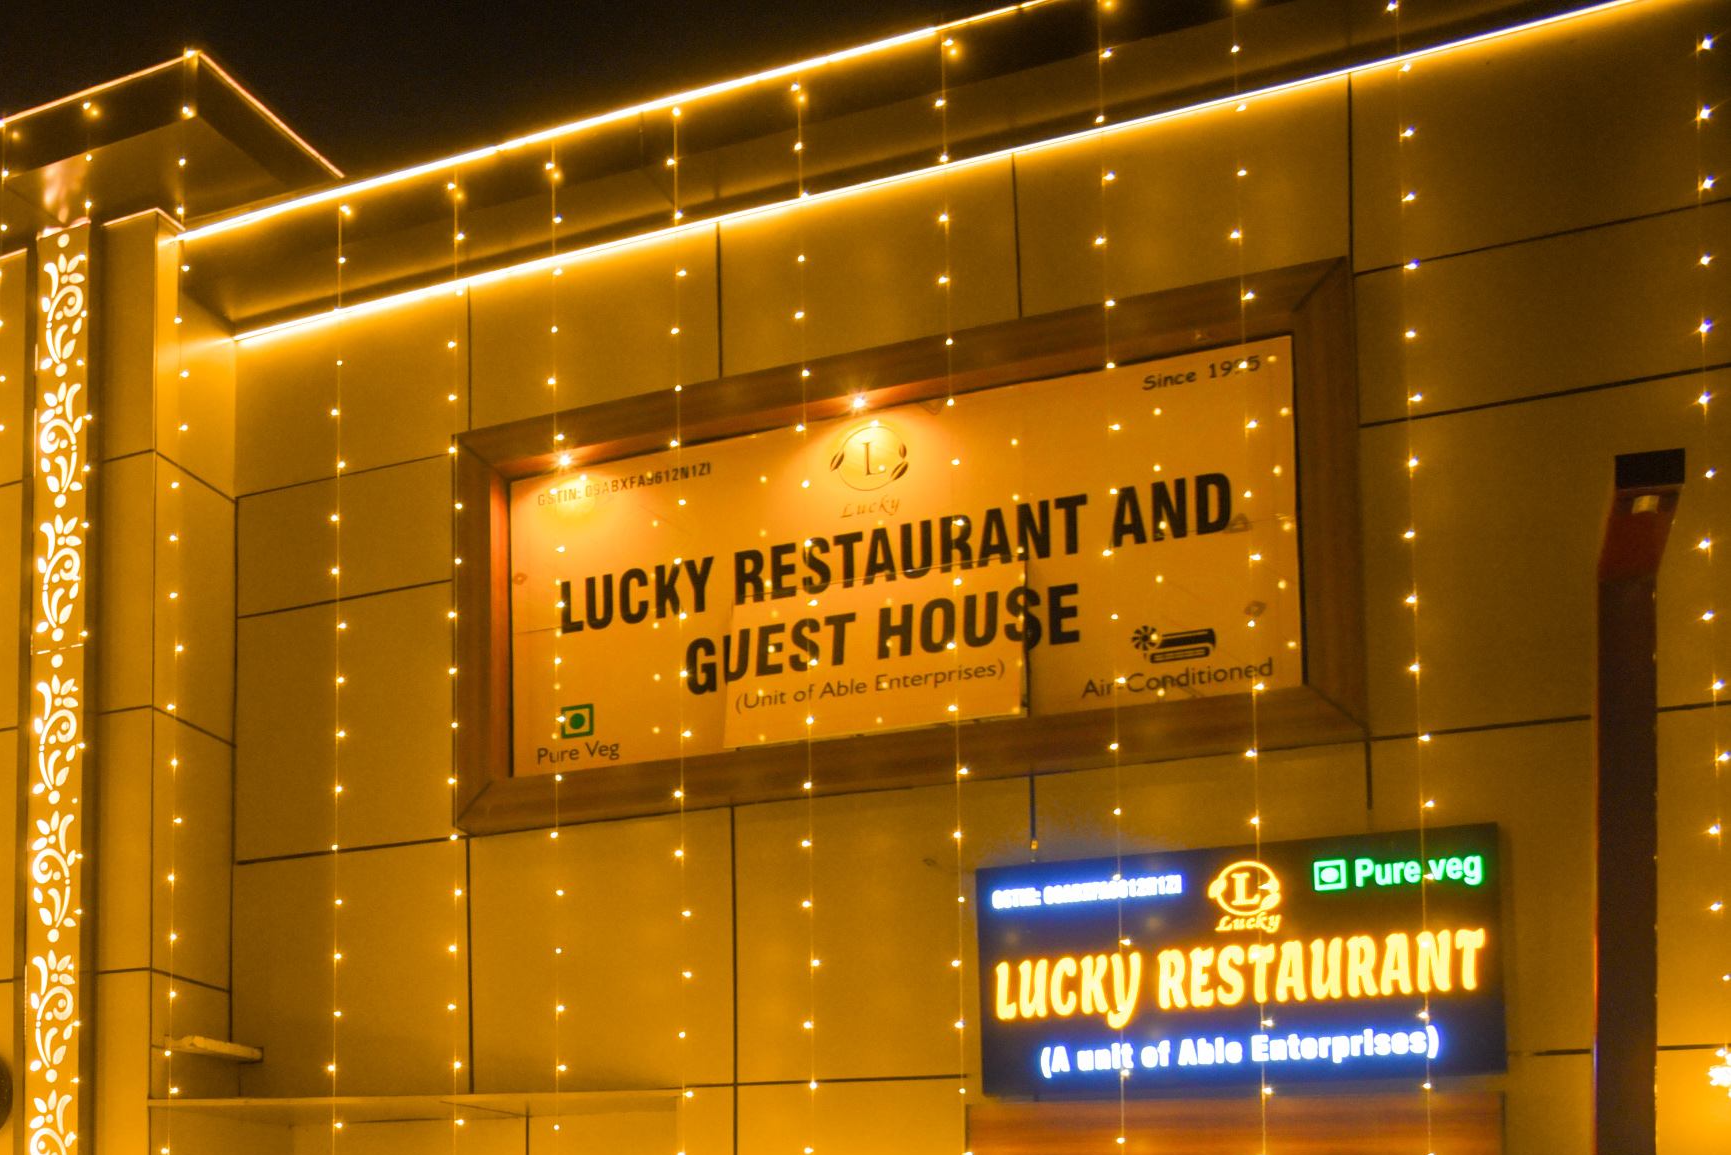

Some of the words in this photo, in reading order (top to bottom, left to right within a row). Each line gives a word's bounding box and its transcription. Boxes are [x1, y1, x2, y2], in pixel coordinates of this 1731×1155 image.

[1142, 371, 1196, 390] Since
[538, 488, 581, 506] GSTIN:
[840, 495, 901, 519] Lucky
[559, 557, 716, 634] LUCKY
[735, 495, 1088, 605] RESTAURANT
[1113, 472, 1231, 546] AND
[686, 613, 856, 696] GUEST
[878, 584, 1080, 661] HOUSE
[735, 687, 786, 714] (Unit
[793, 684, 818, 702] of
[821, 678, 867, 698] Able
[874, 659, 1005, 695] Enterprises)
[1082, 657, 1273, 698] Air-Conditioned
[537, 746, 580, 766] Pure
[585, 741, 620, 760] Veg
[1354, 857, 1421, 887] Pure
[1427, 855, 1483, 886] veg
[1215, 911, 1282, 933] Lucky
[996, 953, 1141, 1029] LUCKY
[1158, 928, 1485, 1010] RESTAURANT
[1040, 1044, 1070, 1079] (A
[1077, 1042, 1132, 1072] unit
[1141, 1038, 1170, 1067] of
[1178, 1036, 1243, 1066] Able
[1251, 1025, 1440, 1064] Enterprises)
